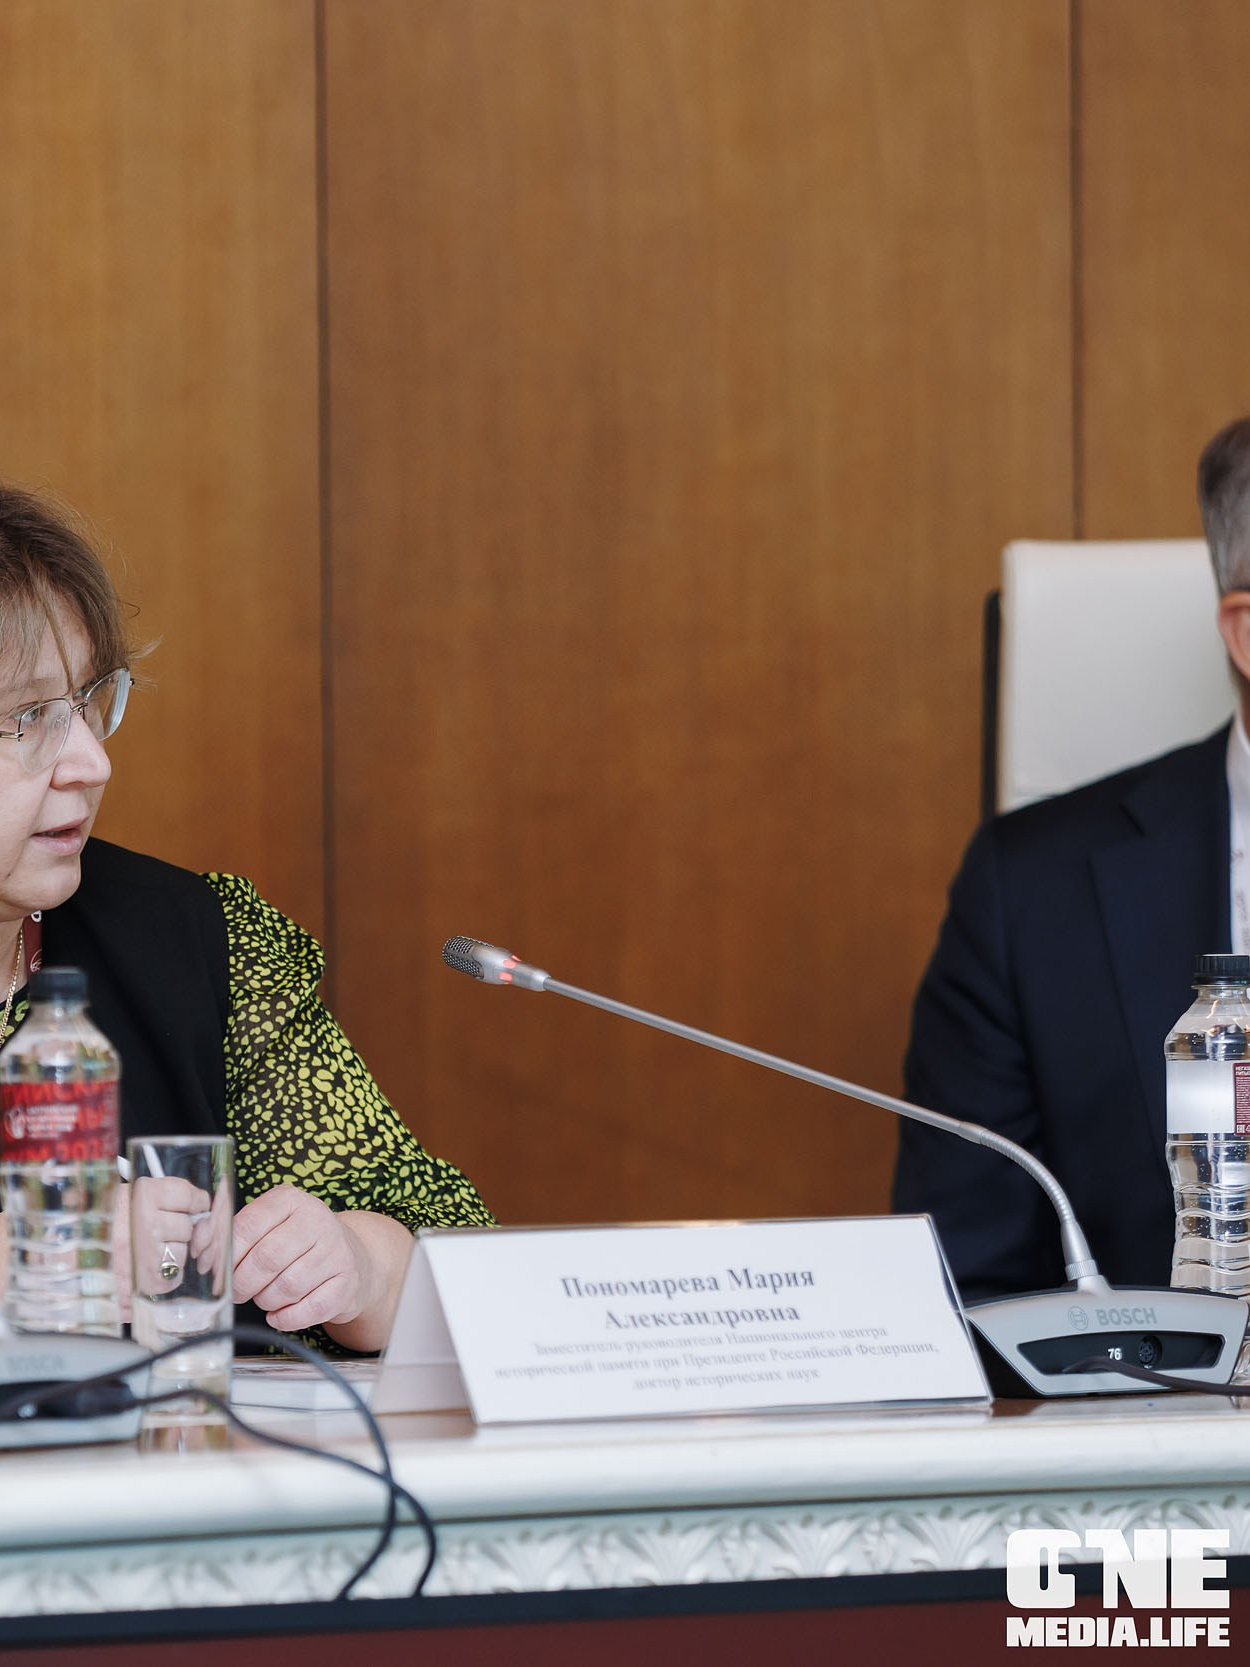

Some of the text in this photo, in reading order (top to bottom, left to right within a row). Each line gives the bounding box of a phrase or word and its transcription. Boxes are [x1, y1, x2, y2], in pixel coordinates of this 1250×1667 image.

[560, 1267, 816, 1300] Пономарева Мария
[604, 1304, 801, 1329] Александровна
[1094, 1307, 1158, 1326] BOSCH
[625, 1335, 722, 1354] руководителя
[726, 1328, 836, 1346] Национального
[840, 1326, 888, 1342] центра
[494, 1359, 594, 1380] исторической
[653, 1356, 680, 1371] при
[682, 1351, 767, 1370] Президенте
[769, 1345, 853, 1362] Российской
[1107, 1347, 1123, 1361] 76
[632, 1368, 821, 1391] доктор исторических наук
